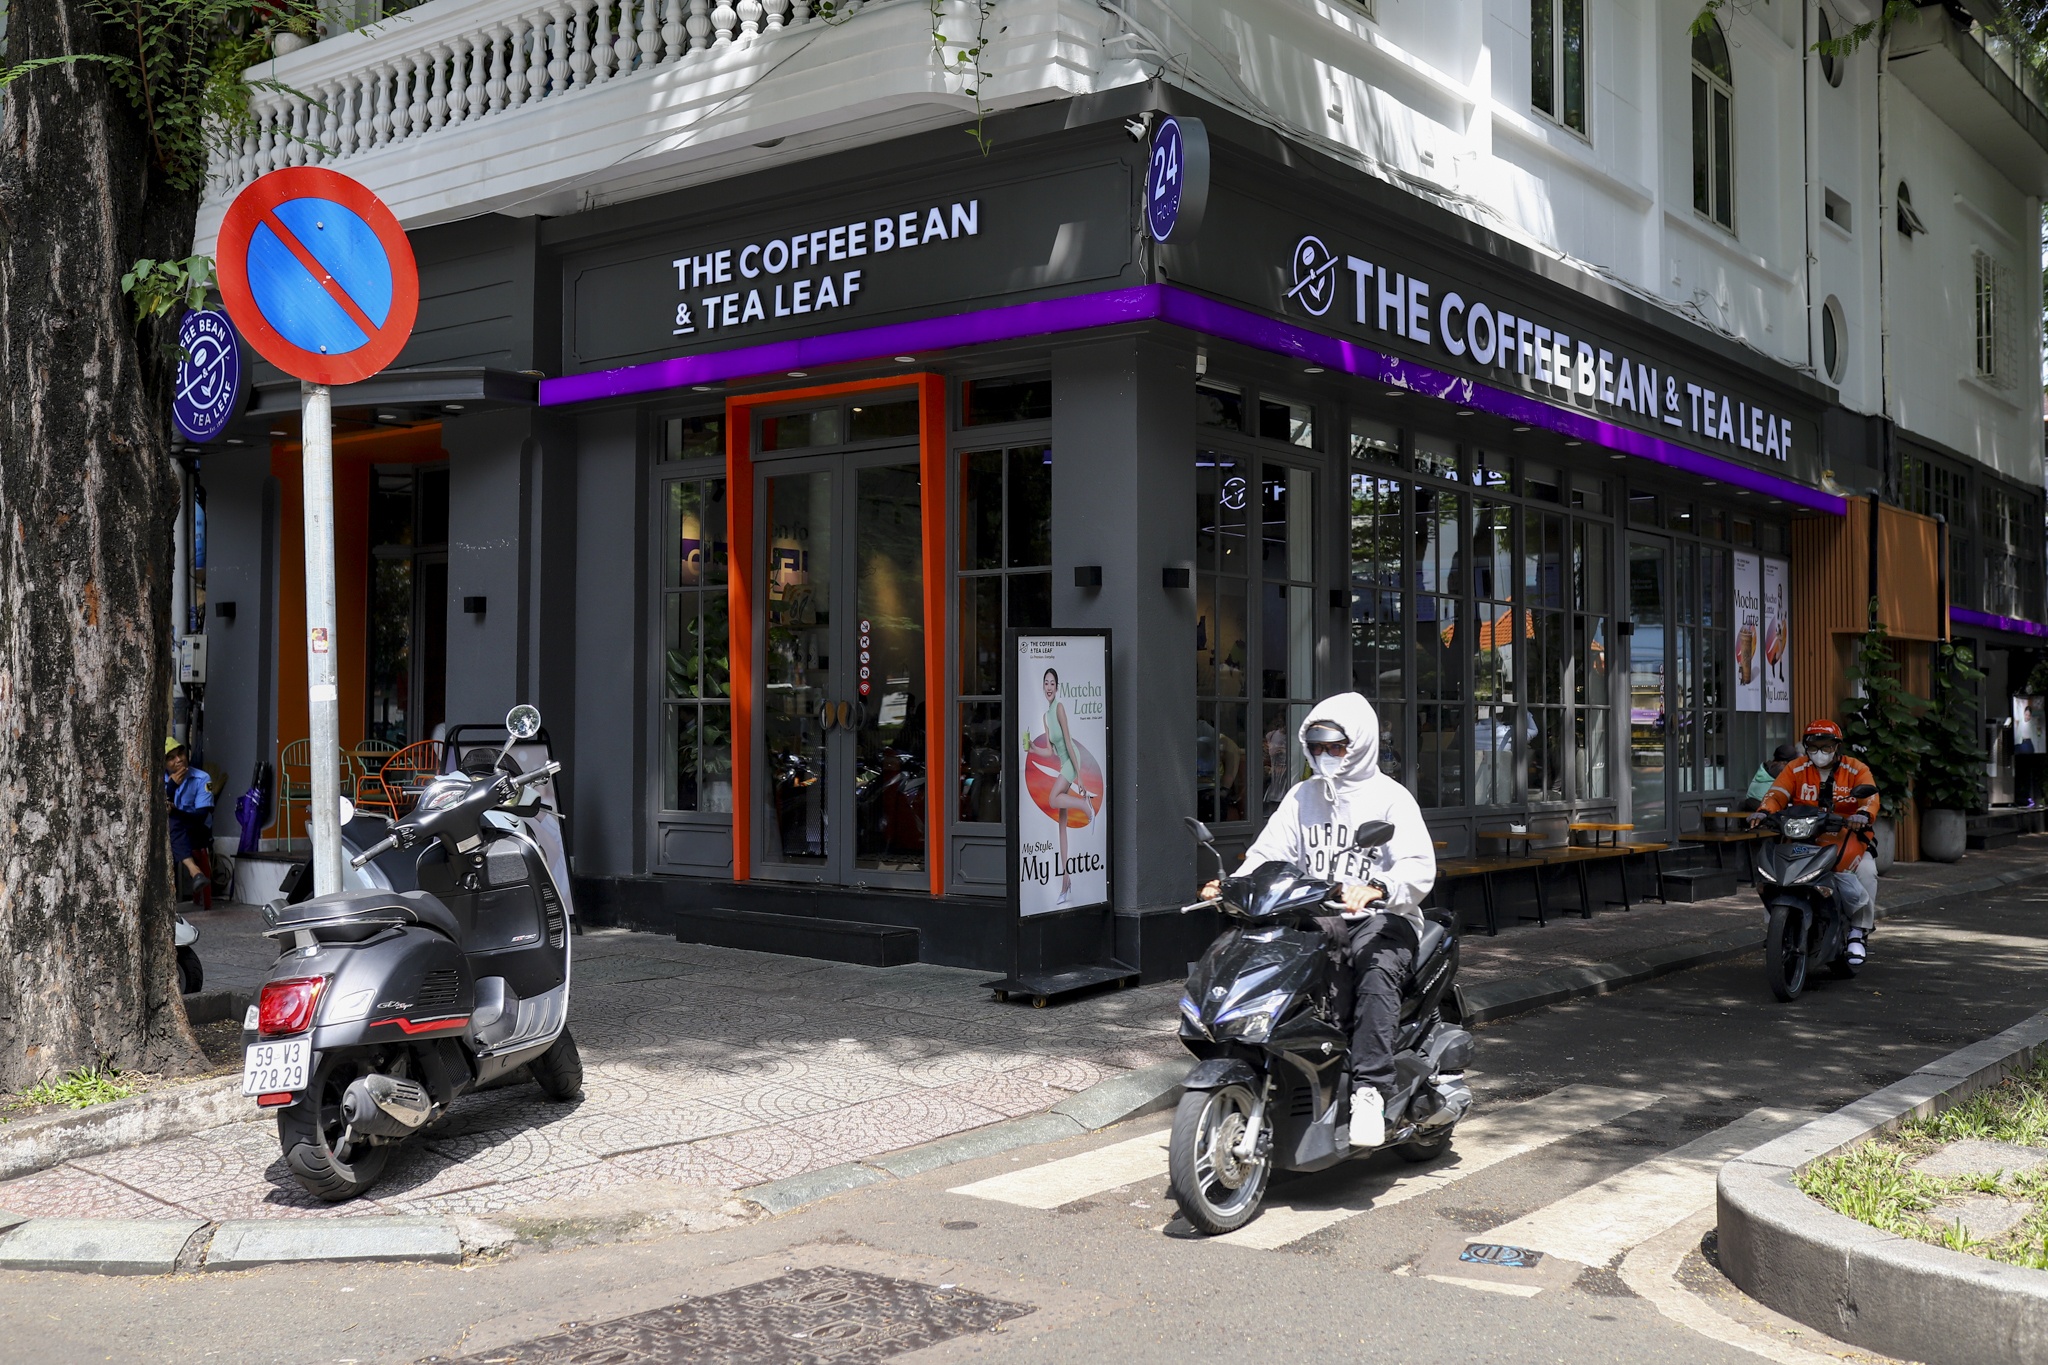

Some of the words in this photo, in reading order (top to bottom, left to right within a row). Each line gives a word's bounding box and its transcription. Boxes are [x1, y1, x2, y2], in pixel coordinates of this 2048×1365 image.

[1155, 133, 1178, 201] 24
[673, 249, 732, 291] THE
[739, 221, 867, 279] COFFEE
[874, 199, 978, 253] BEAN
[674, 303, 693, 330] &
[702, 293, 765, 329] TEA
[774, 270, 861, 318] LEAF
[199, 318, 226, 342] BEAN
[1347, 255, 1431, 345] THE
[1440, 292, 1572, 390] COFFEE
[1577, 340, 1658, 418] BEAN
[1664, 375, 1682, 421] &
[1686, 382, 1735, 444] TEA
[1739, 402, 1792, 462] LEAF
[193, 412, 211, 427] TEA
[213, 381, 232, 419] LEAF
[1733, 589, 1758, 610] Mocha
[1742, 610, 1759, 626] Latte
[1060, 681, 1102, 698] Matcha
[1074, 699, 1103, 715] Latte
[1022, 843, 1034, 855] My
[1034, 840, 1053, 853] Style.
[1021, 855, 1049, 885] My
[1055, 852, 1104, 877] Latte.
[248, 1065, 302, 1092] 728.29
